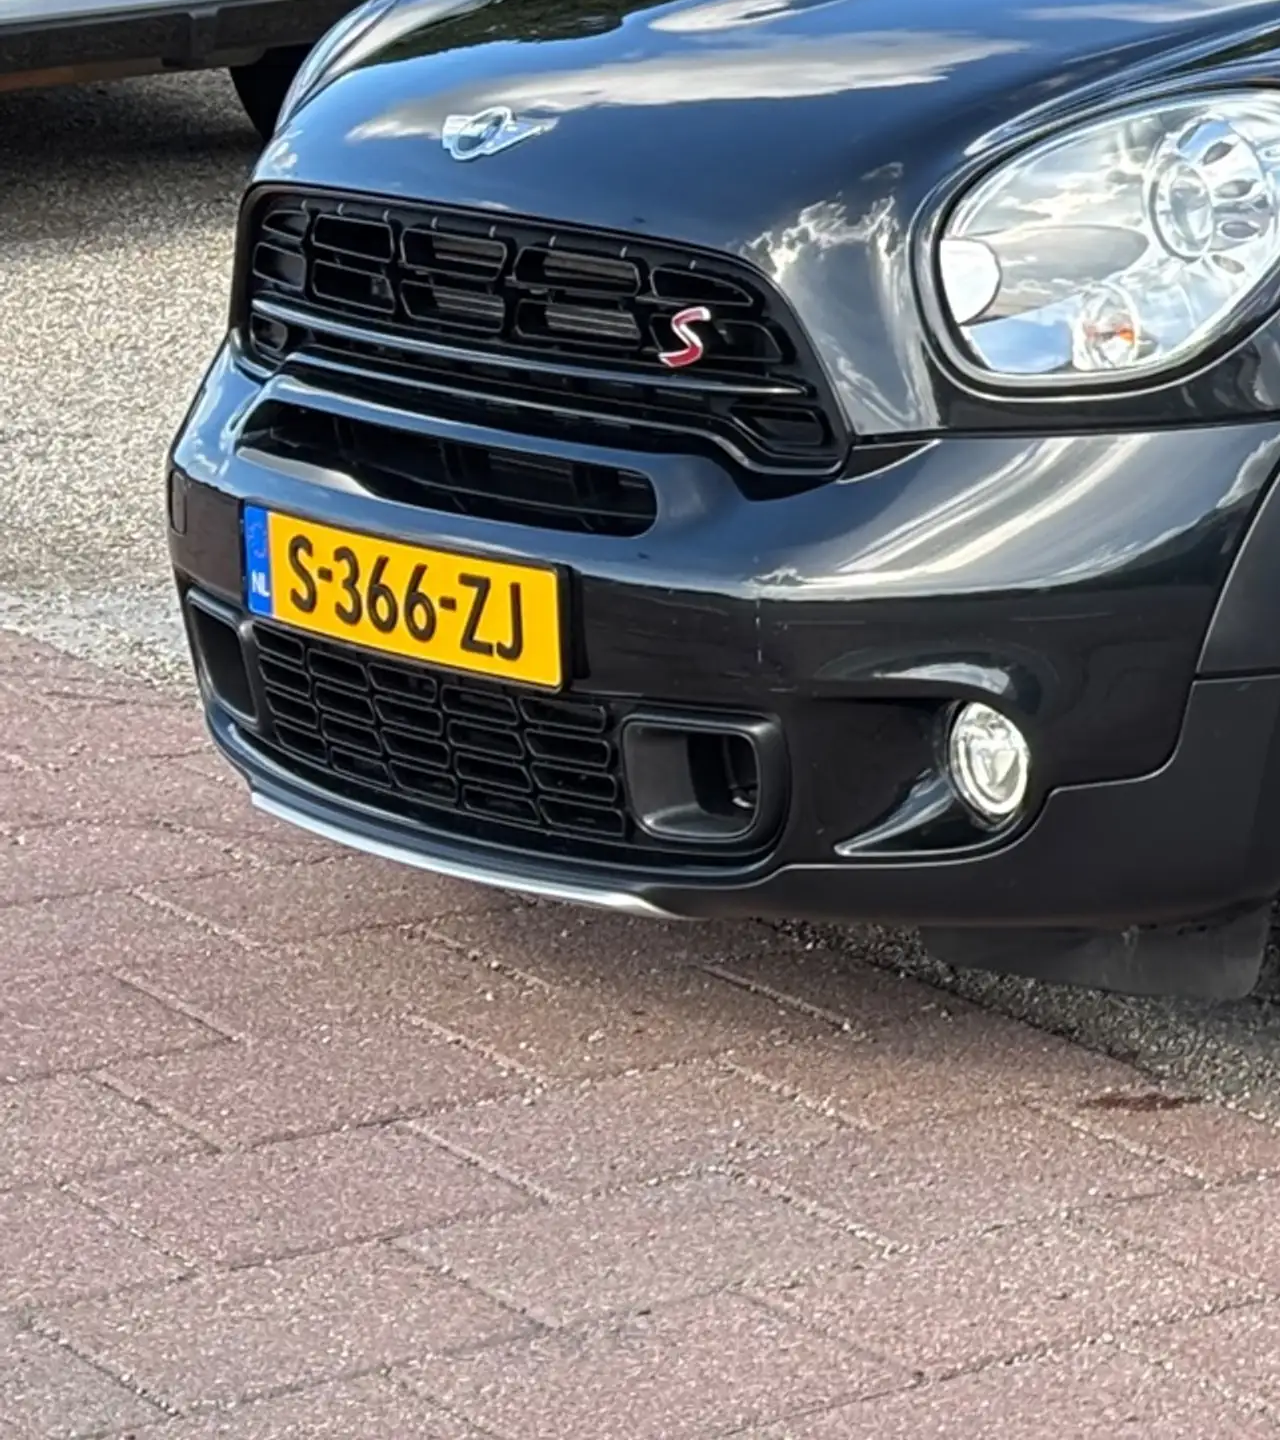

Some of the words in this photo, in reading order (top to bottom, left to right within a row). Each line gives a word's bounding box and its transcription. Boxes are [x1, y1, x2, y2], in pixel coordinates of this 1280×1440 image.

[658, 306, 711, 367] S
[251, 569, 271, 598] NL
[288, 533, 524, 662] S-366-ZJ
